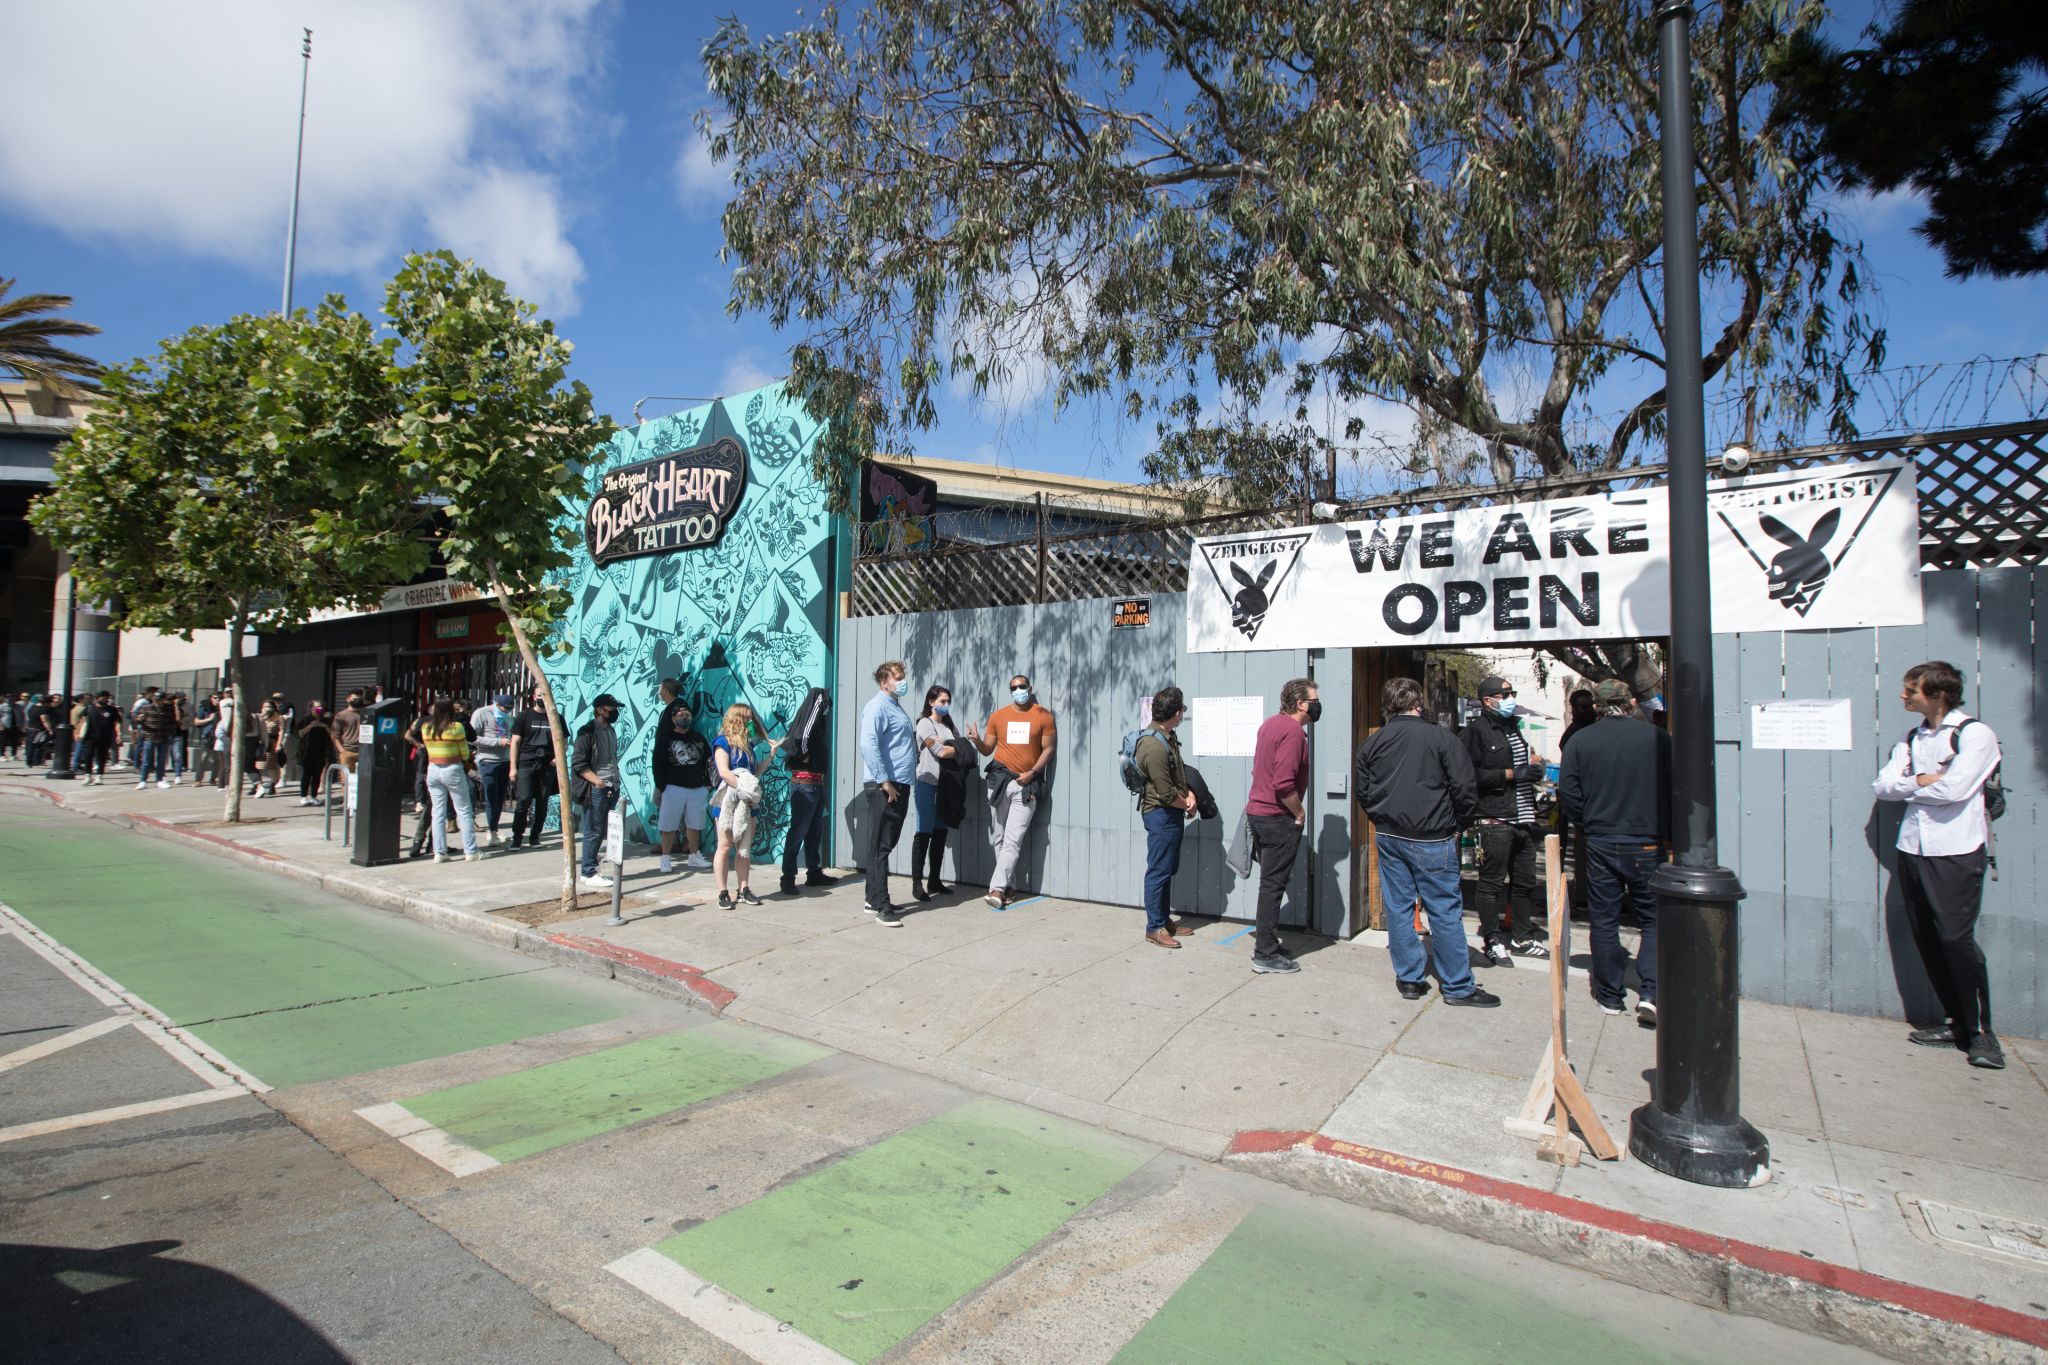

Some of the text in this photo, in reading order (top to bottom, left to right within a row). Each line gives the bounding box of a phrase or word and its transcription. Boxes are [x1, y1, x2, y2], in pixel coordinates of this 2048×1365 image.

[605, 467, 648, 495] The Original
[634, 513, 717, 551] TATTOO
[1345, 499, 1649, 573] WE ARE
[1211, 541, 1300, 560] ZEITGEIST
[1124, 602, 1138, 613] NO
[1382, 571, 1600, 636] OPEN
[435, 621, 466, 634] TATTOO
[1114, 613, 1149, 626] PARKING
[1352, 1146, 1439, 1177] SFMTA
